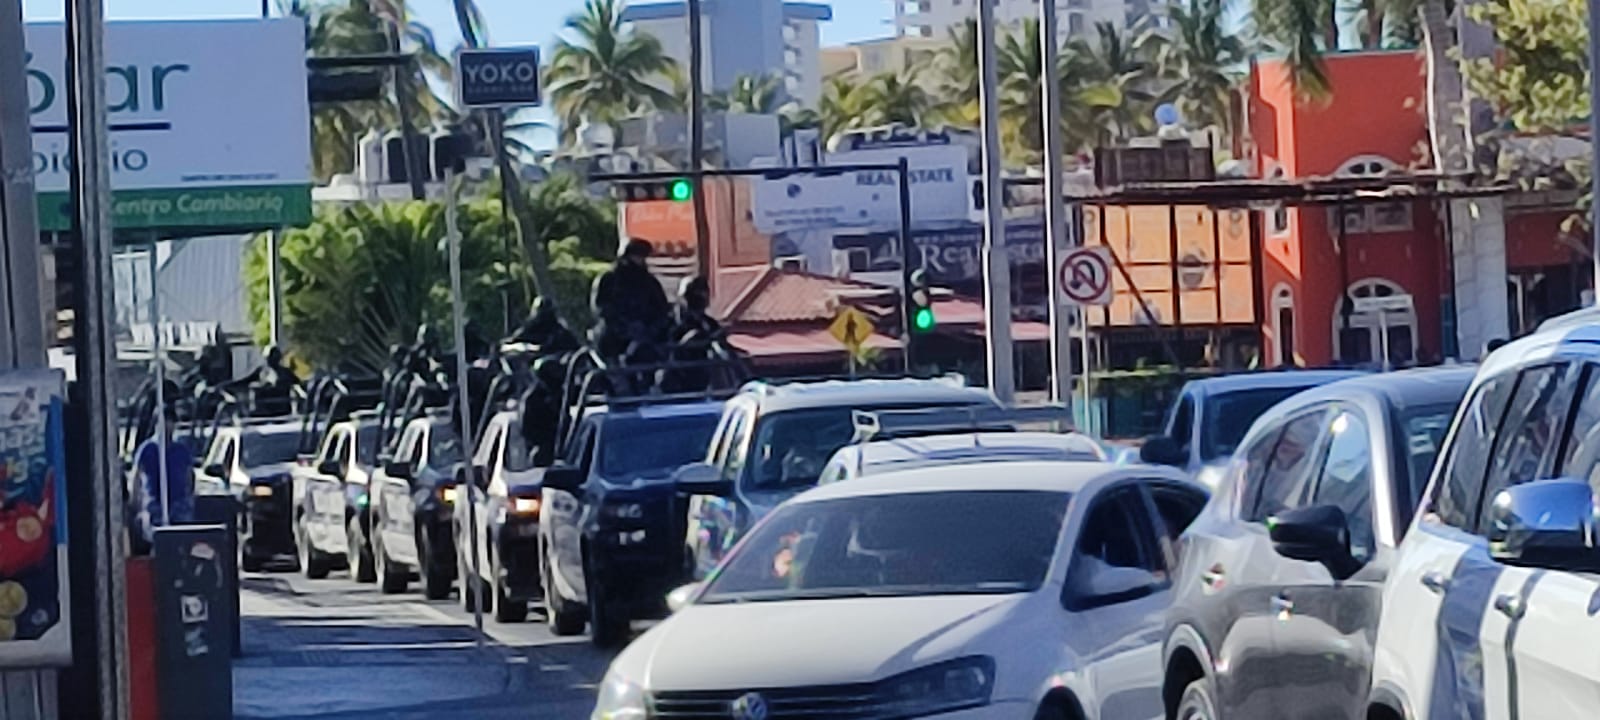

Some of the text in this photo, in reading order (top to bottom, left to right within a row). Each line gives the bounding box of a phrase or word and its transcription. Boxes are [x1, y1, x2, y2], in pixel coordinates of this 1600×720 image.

[464, 62, 533, 84] YOKO
[856, 170, 896, 186] REAL
[176, 190, 284, 215] Cambiario
